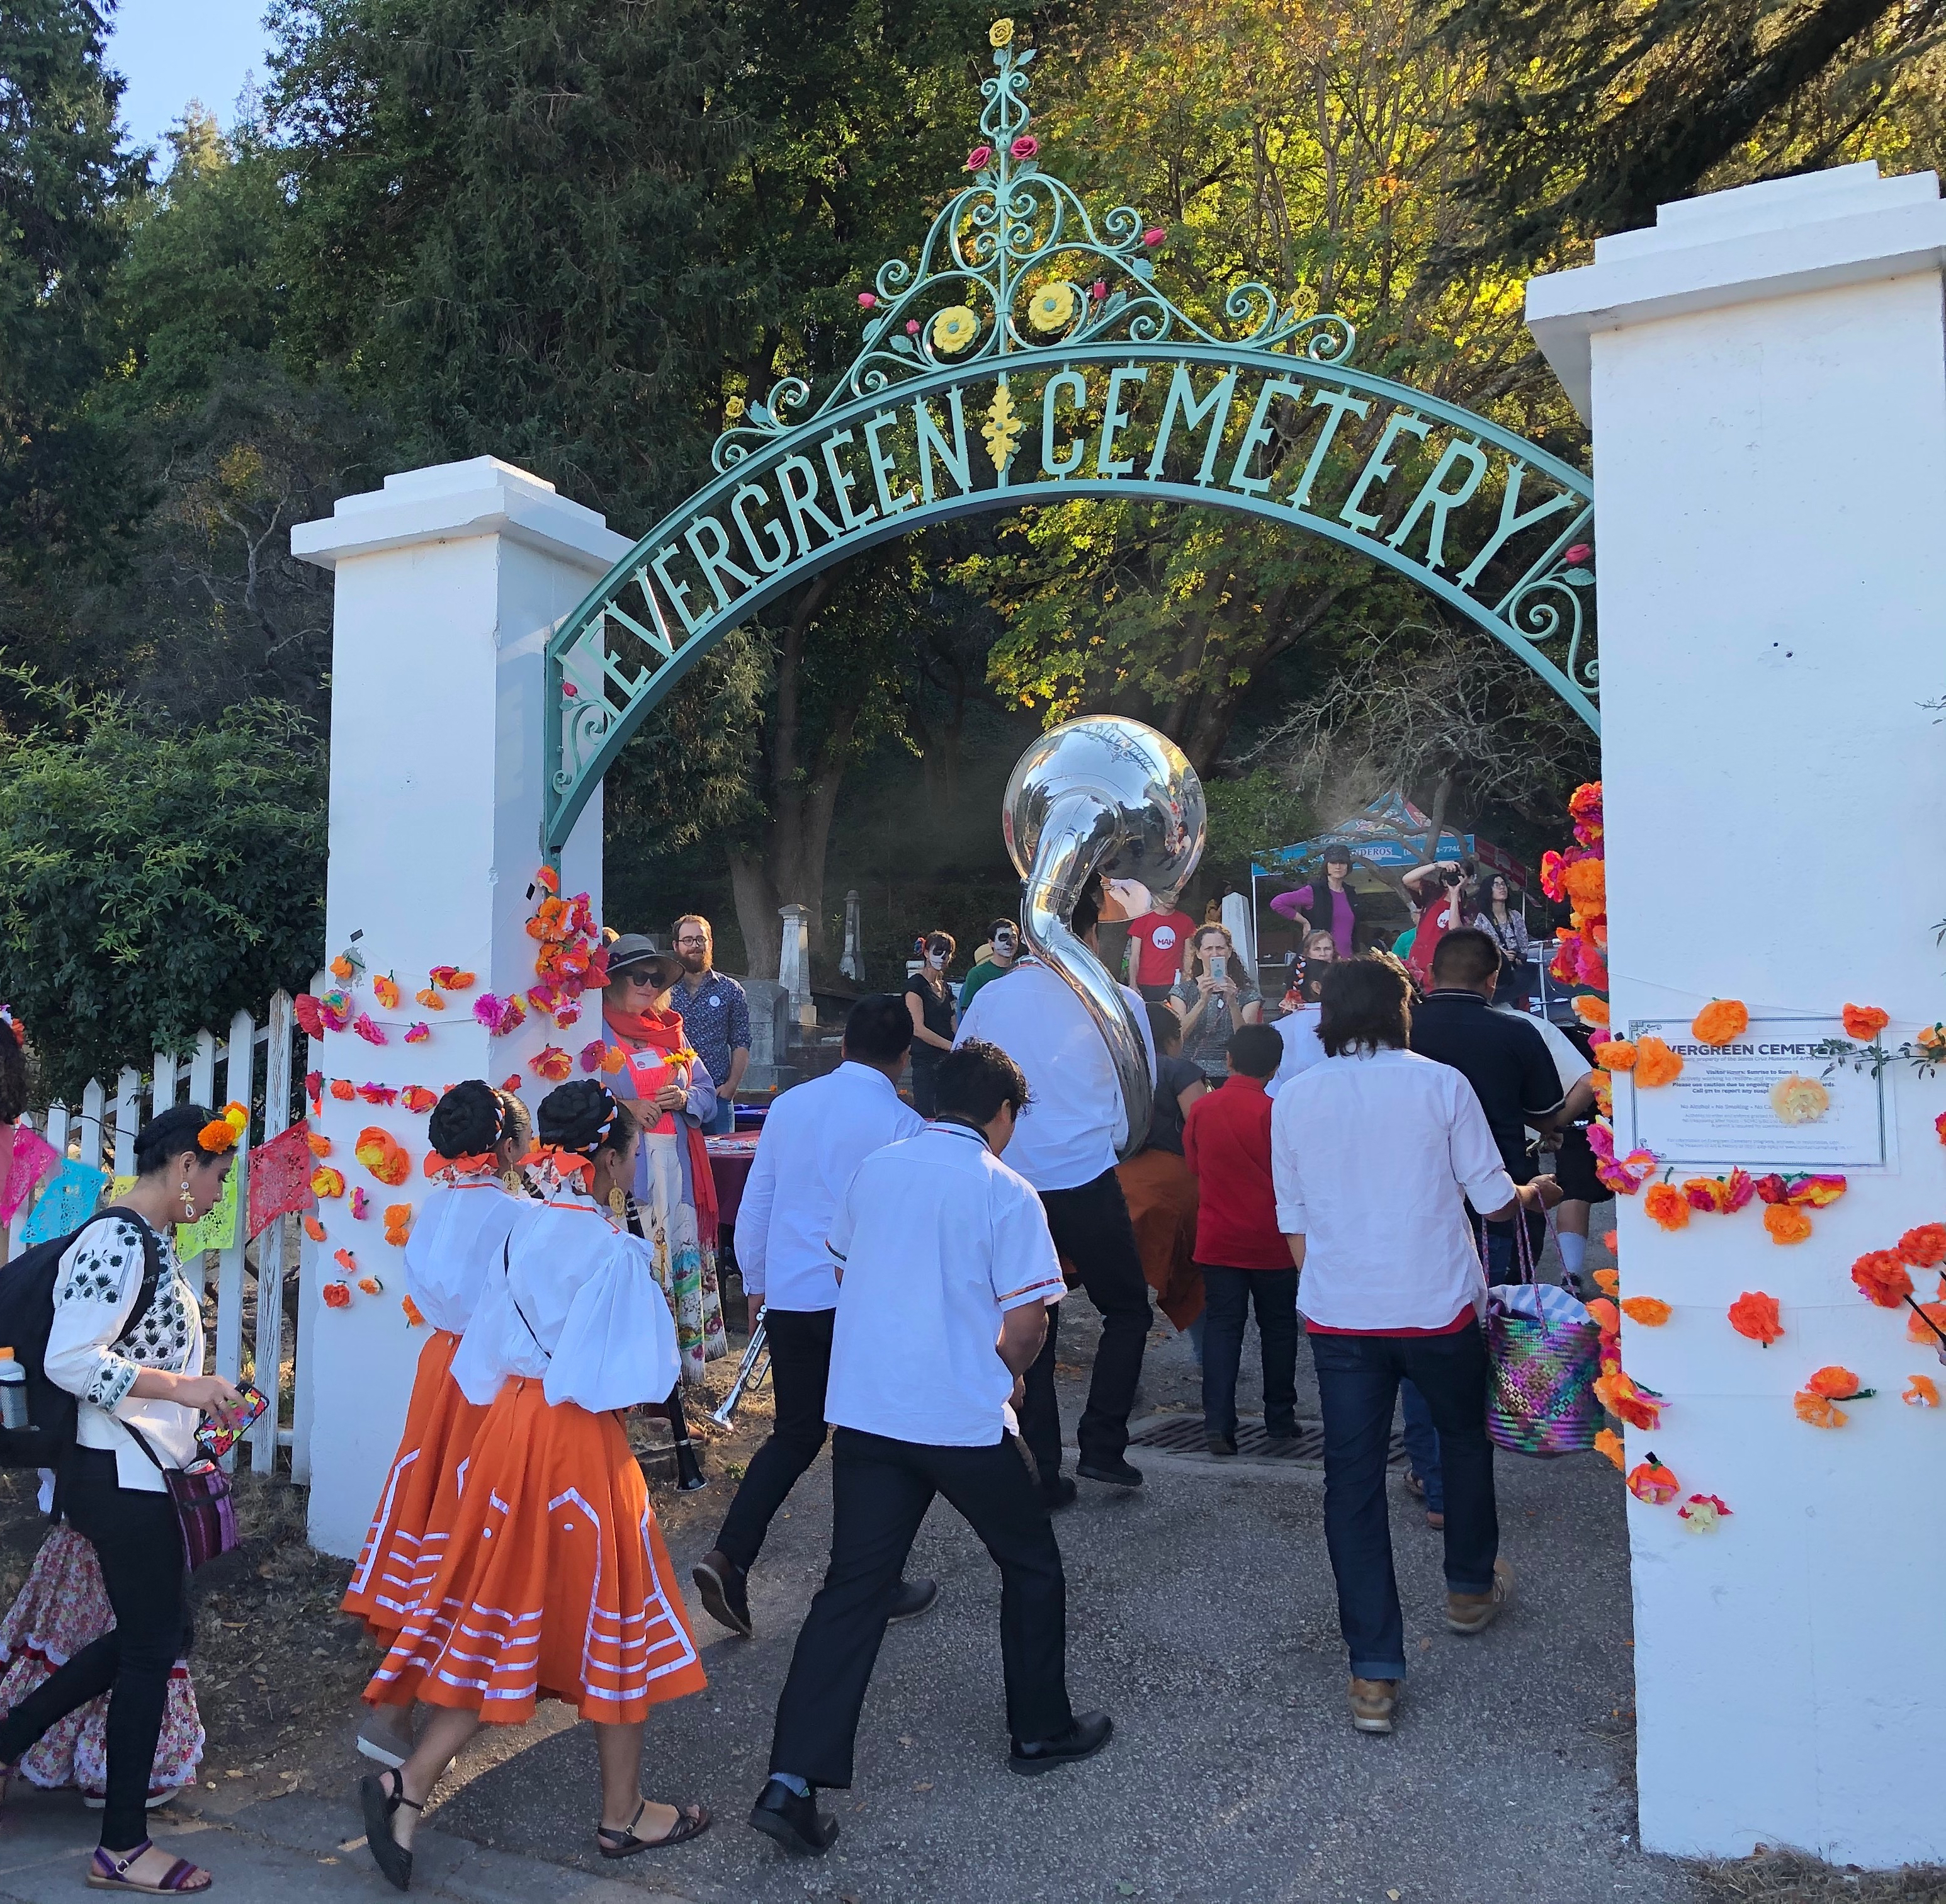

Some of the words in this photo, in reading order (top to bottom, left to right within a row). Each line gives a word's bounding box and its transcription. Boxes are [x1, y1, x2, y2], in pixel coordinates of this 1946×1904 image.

[580, 384, 972, 700] EVERGREEN
[1041, 359, 1576, 590] CEMETERY
[1352, 846, 1393, 856] NDEROS
[1666, 1045, 1754, 1055] VERGREEN
[1758, 1044, 1828, 1055] CEMETE
